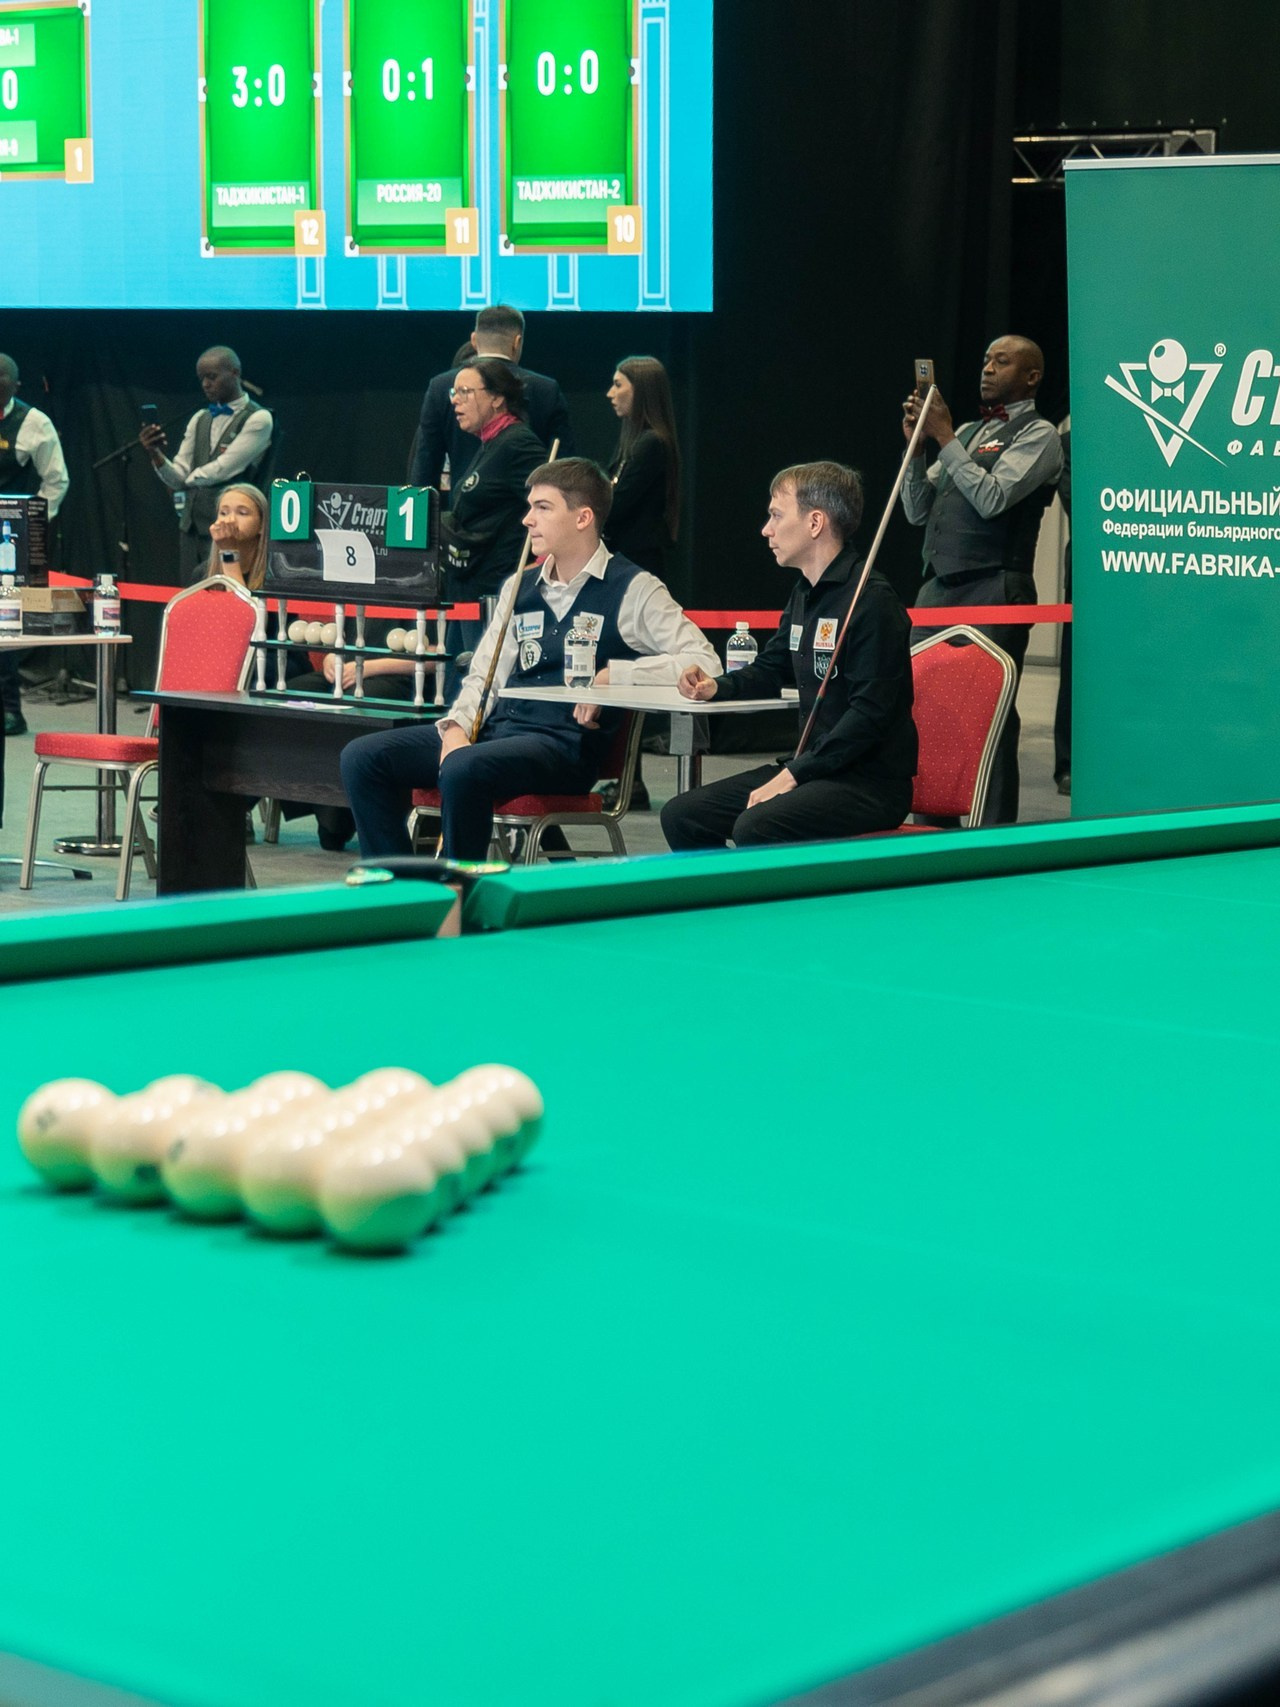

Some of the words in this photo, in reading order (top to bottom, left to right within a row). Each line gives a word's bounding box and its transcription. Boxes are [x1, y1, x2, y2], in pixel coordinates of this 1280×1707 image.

[232, 64, 286, 108] 3:0
[382, 57, 434, 102] 0:1
[537, 49, 599, 96] 0:0
[74, 146, 83, 173] 1
[216, 185, 305, 207] ТАДЖИКИСТАН-1
[376, 183, 442, 203] РОССИЯ-20
[517, 179, 621, 202] ТАДЖИКИСТАН-2
[301, 218, 320, 246] 12
[454, 216, 470, 244] 11
[614, 214, 636, 243] 10
[281, 489, 300, 533] 0
[351, 503, 388, 527] Старт
[399, 497, 414, 541] 1
[1102, 518, 1184, 540] Федерации
[346, 546, 357, 566] 8
